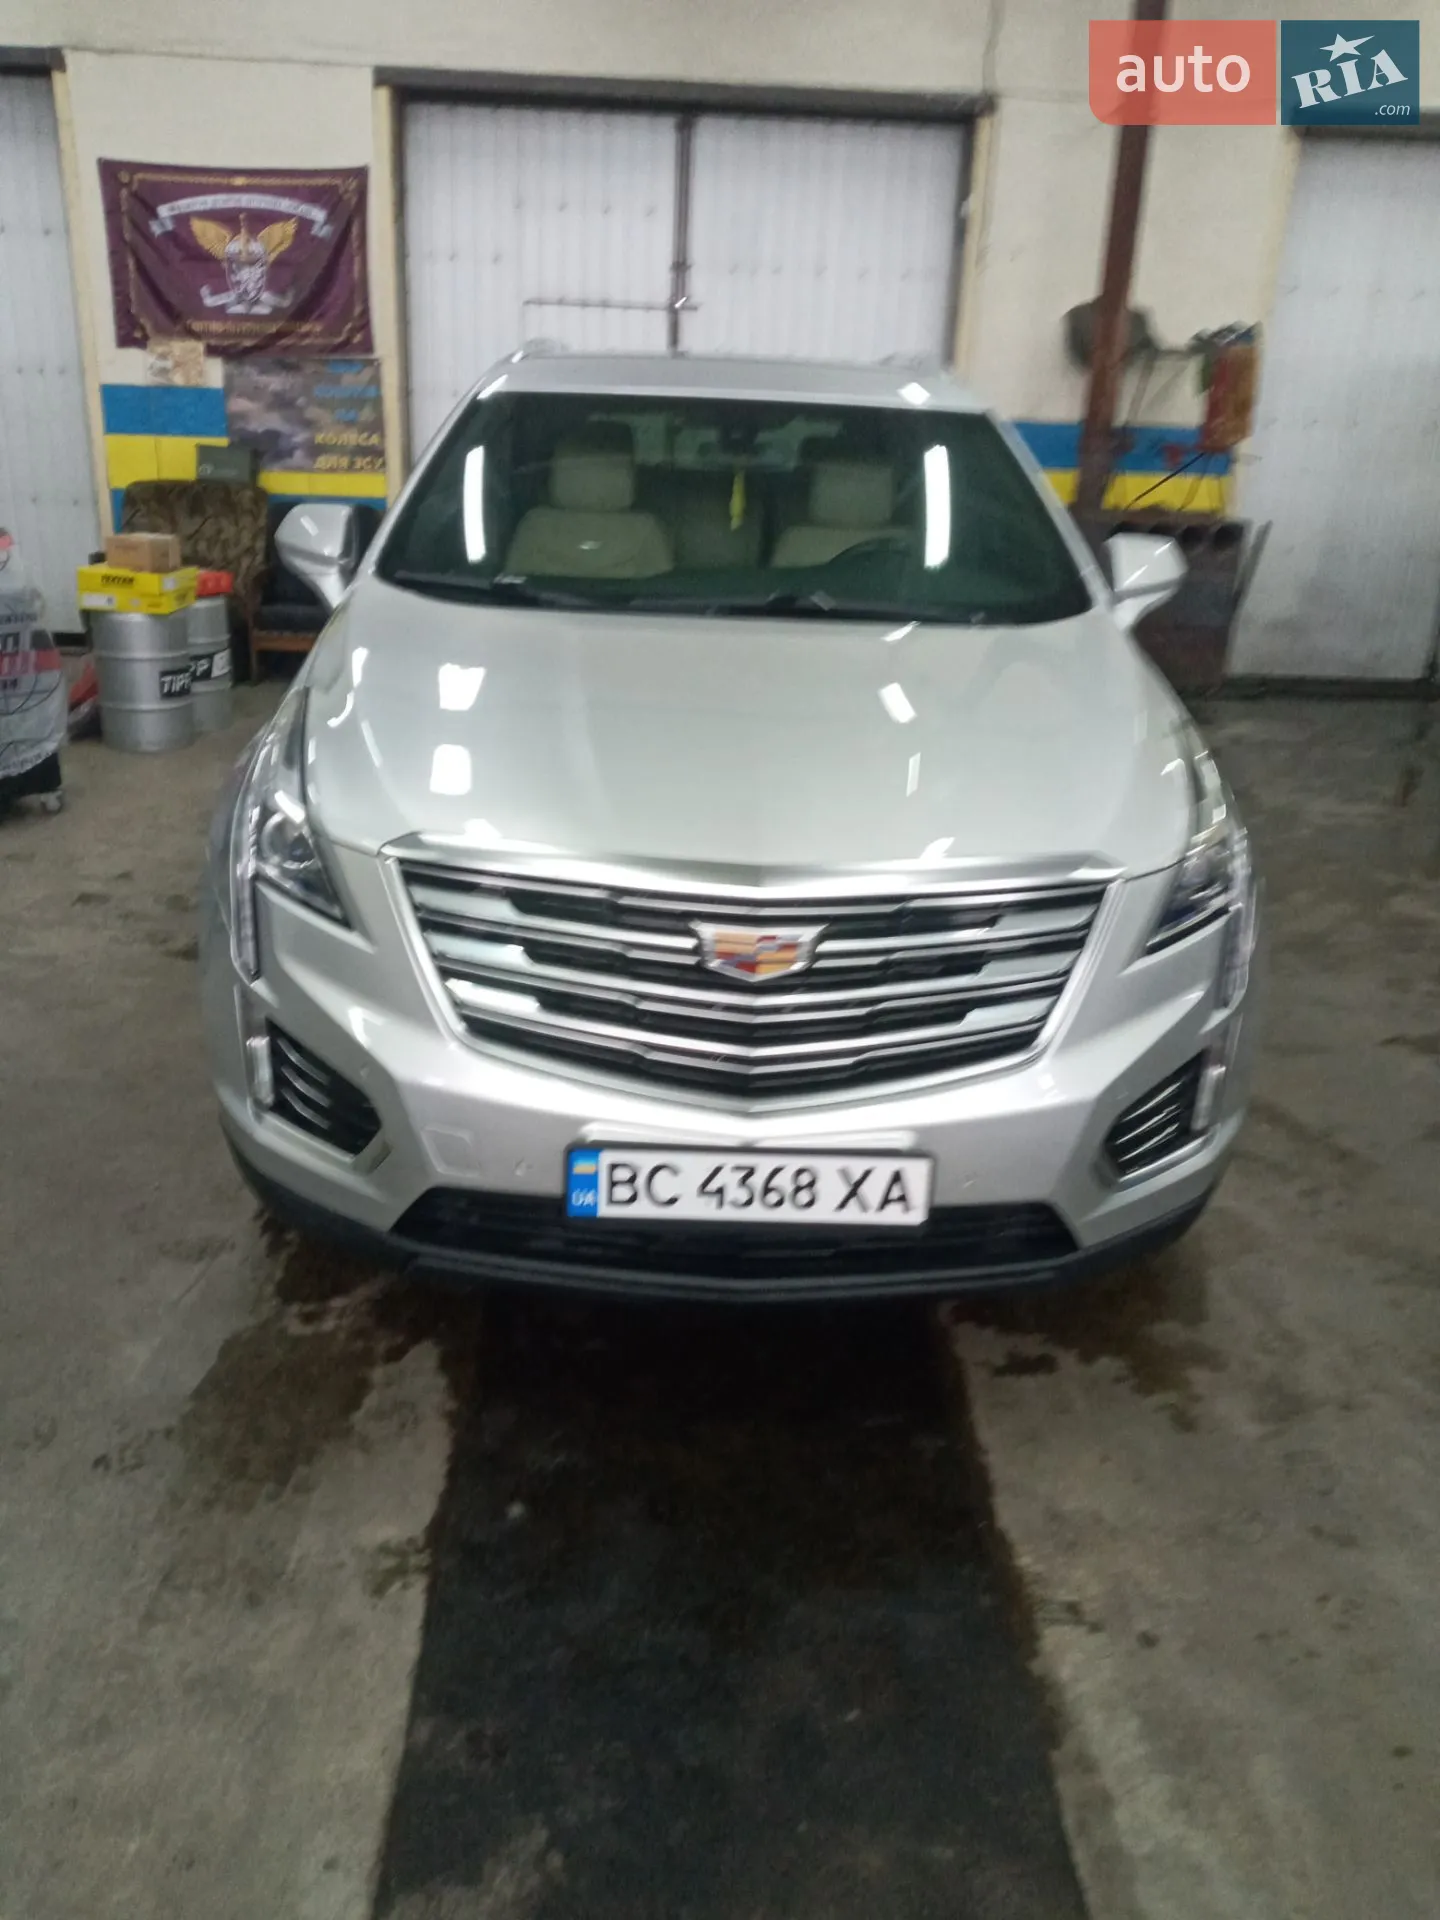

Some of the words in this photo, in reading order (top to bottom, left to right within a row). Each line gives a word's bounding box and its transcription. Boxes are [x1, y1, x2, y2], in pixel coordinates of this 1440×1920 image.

[572, 1189, 597, 1207] UA
[606, 1162, 680, 1207] BC
[697, 1165, 817, 1210] 4368
[833, 1167, 913, 1214] XA
